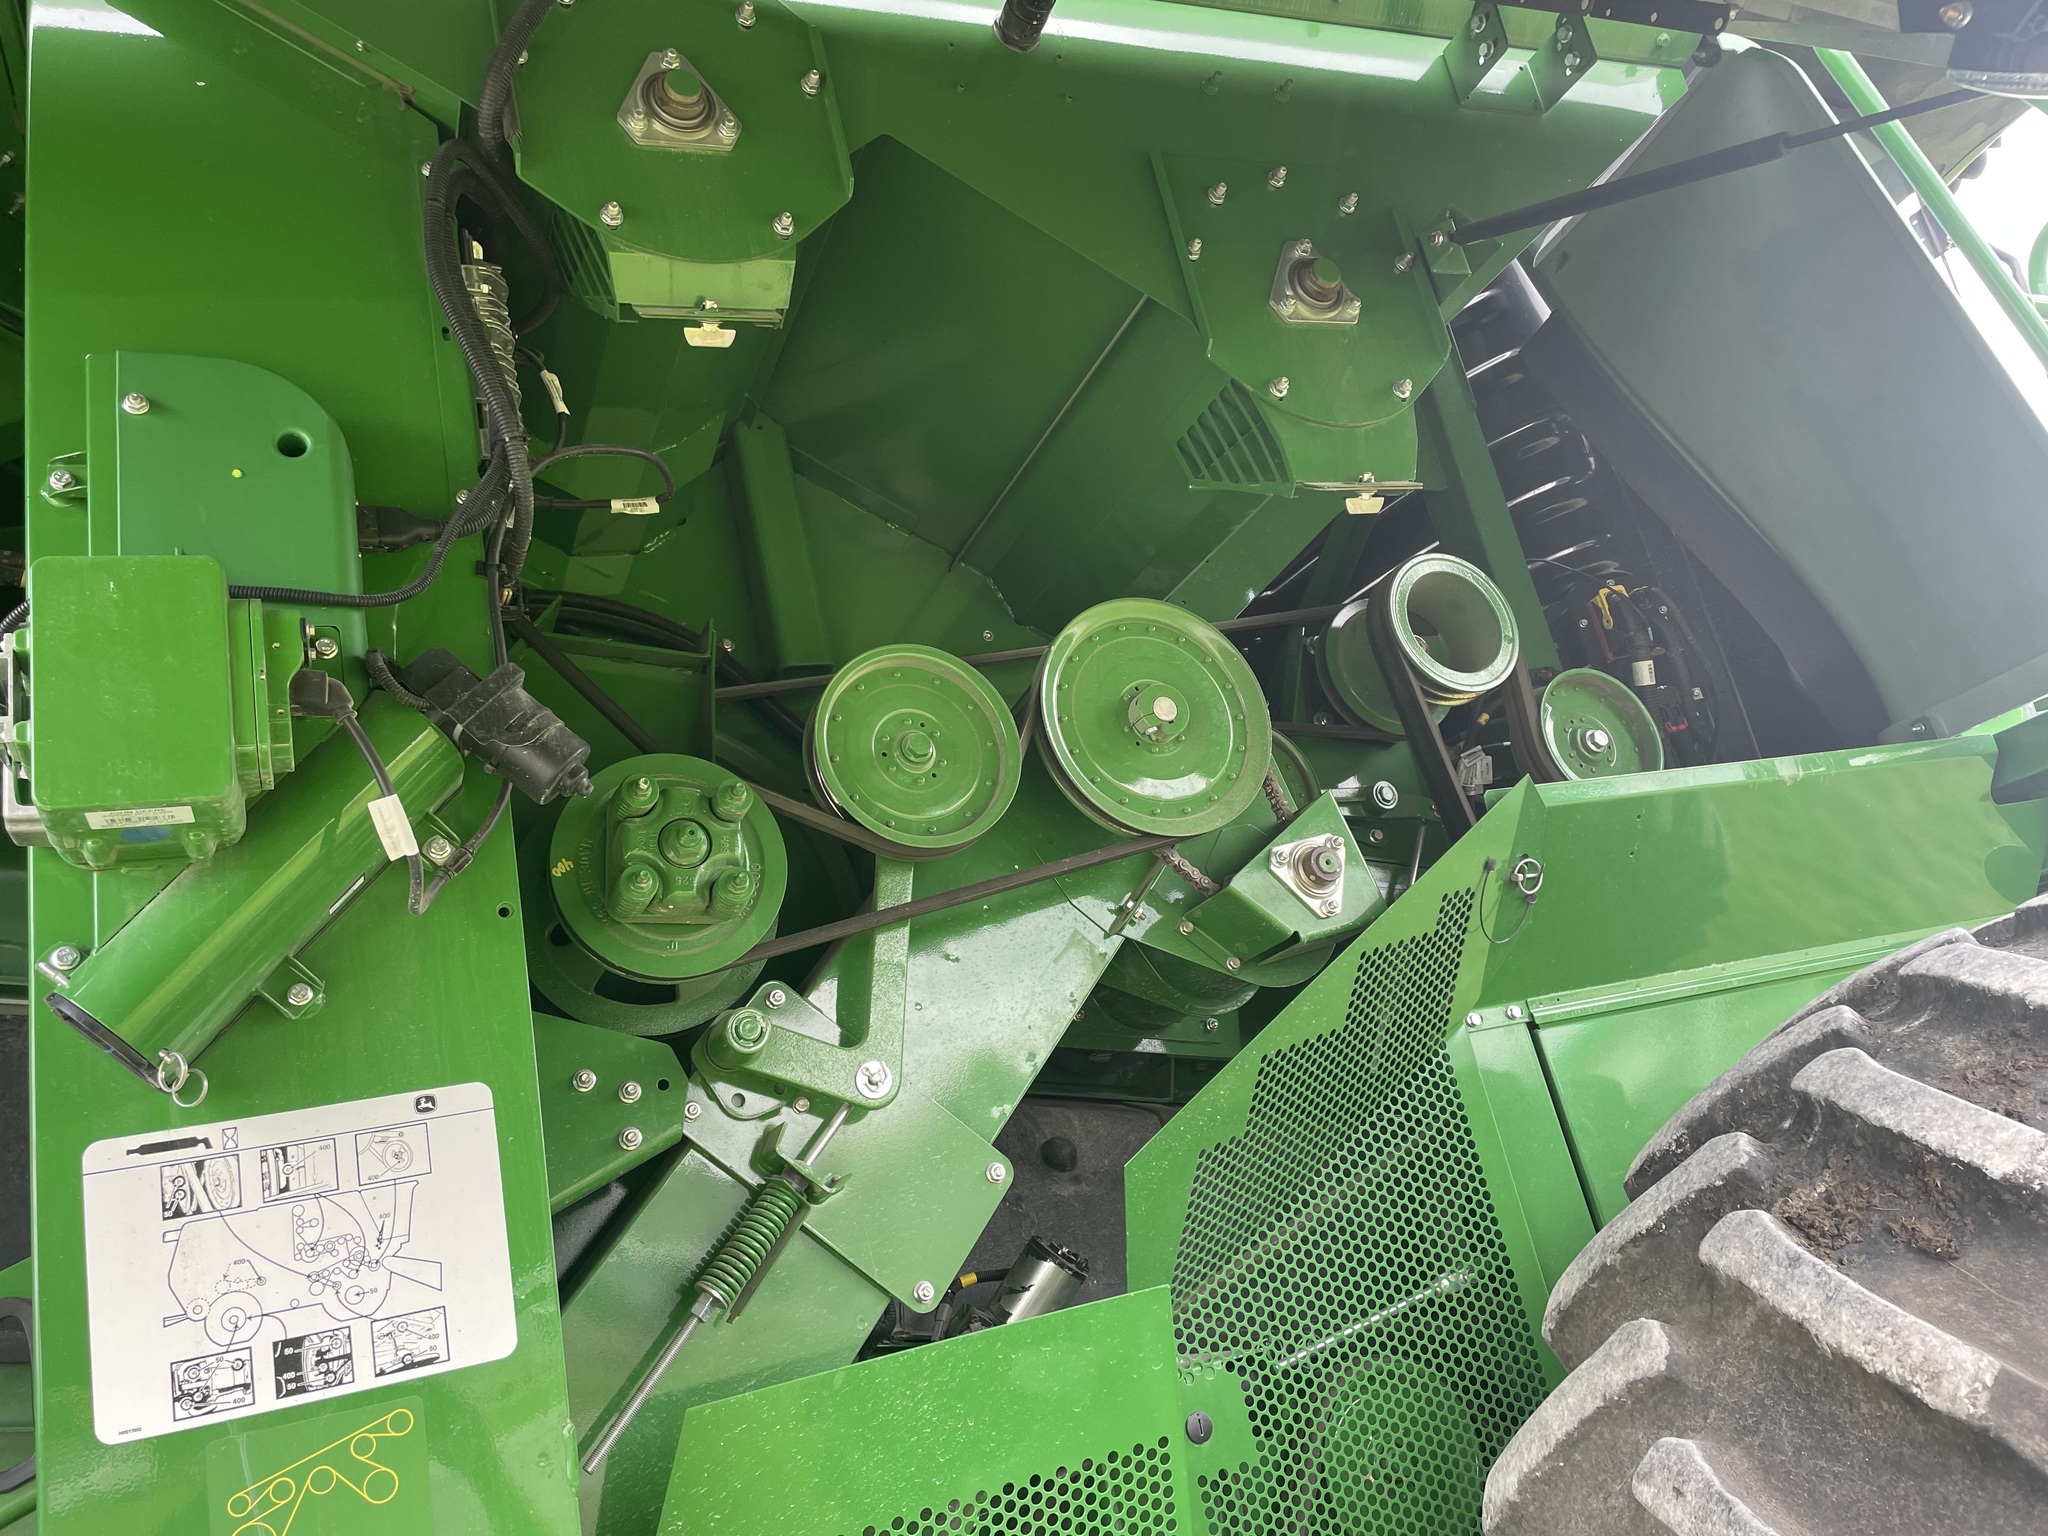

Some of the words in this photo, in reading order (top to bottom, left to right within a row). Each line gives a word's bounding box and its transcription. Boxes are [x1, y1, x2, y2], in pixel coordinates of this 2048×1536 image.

[552, 858, 574, 878] 400
[164, 1210, 173, 1218] 50
[283, 1371, 295, 1380] 400
